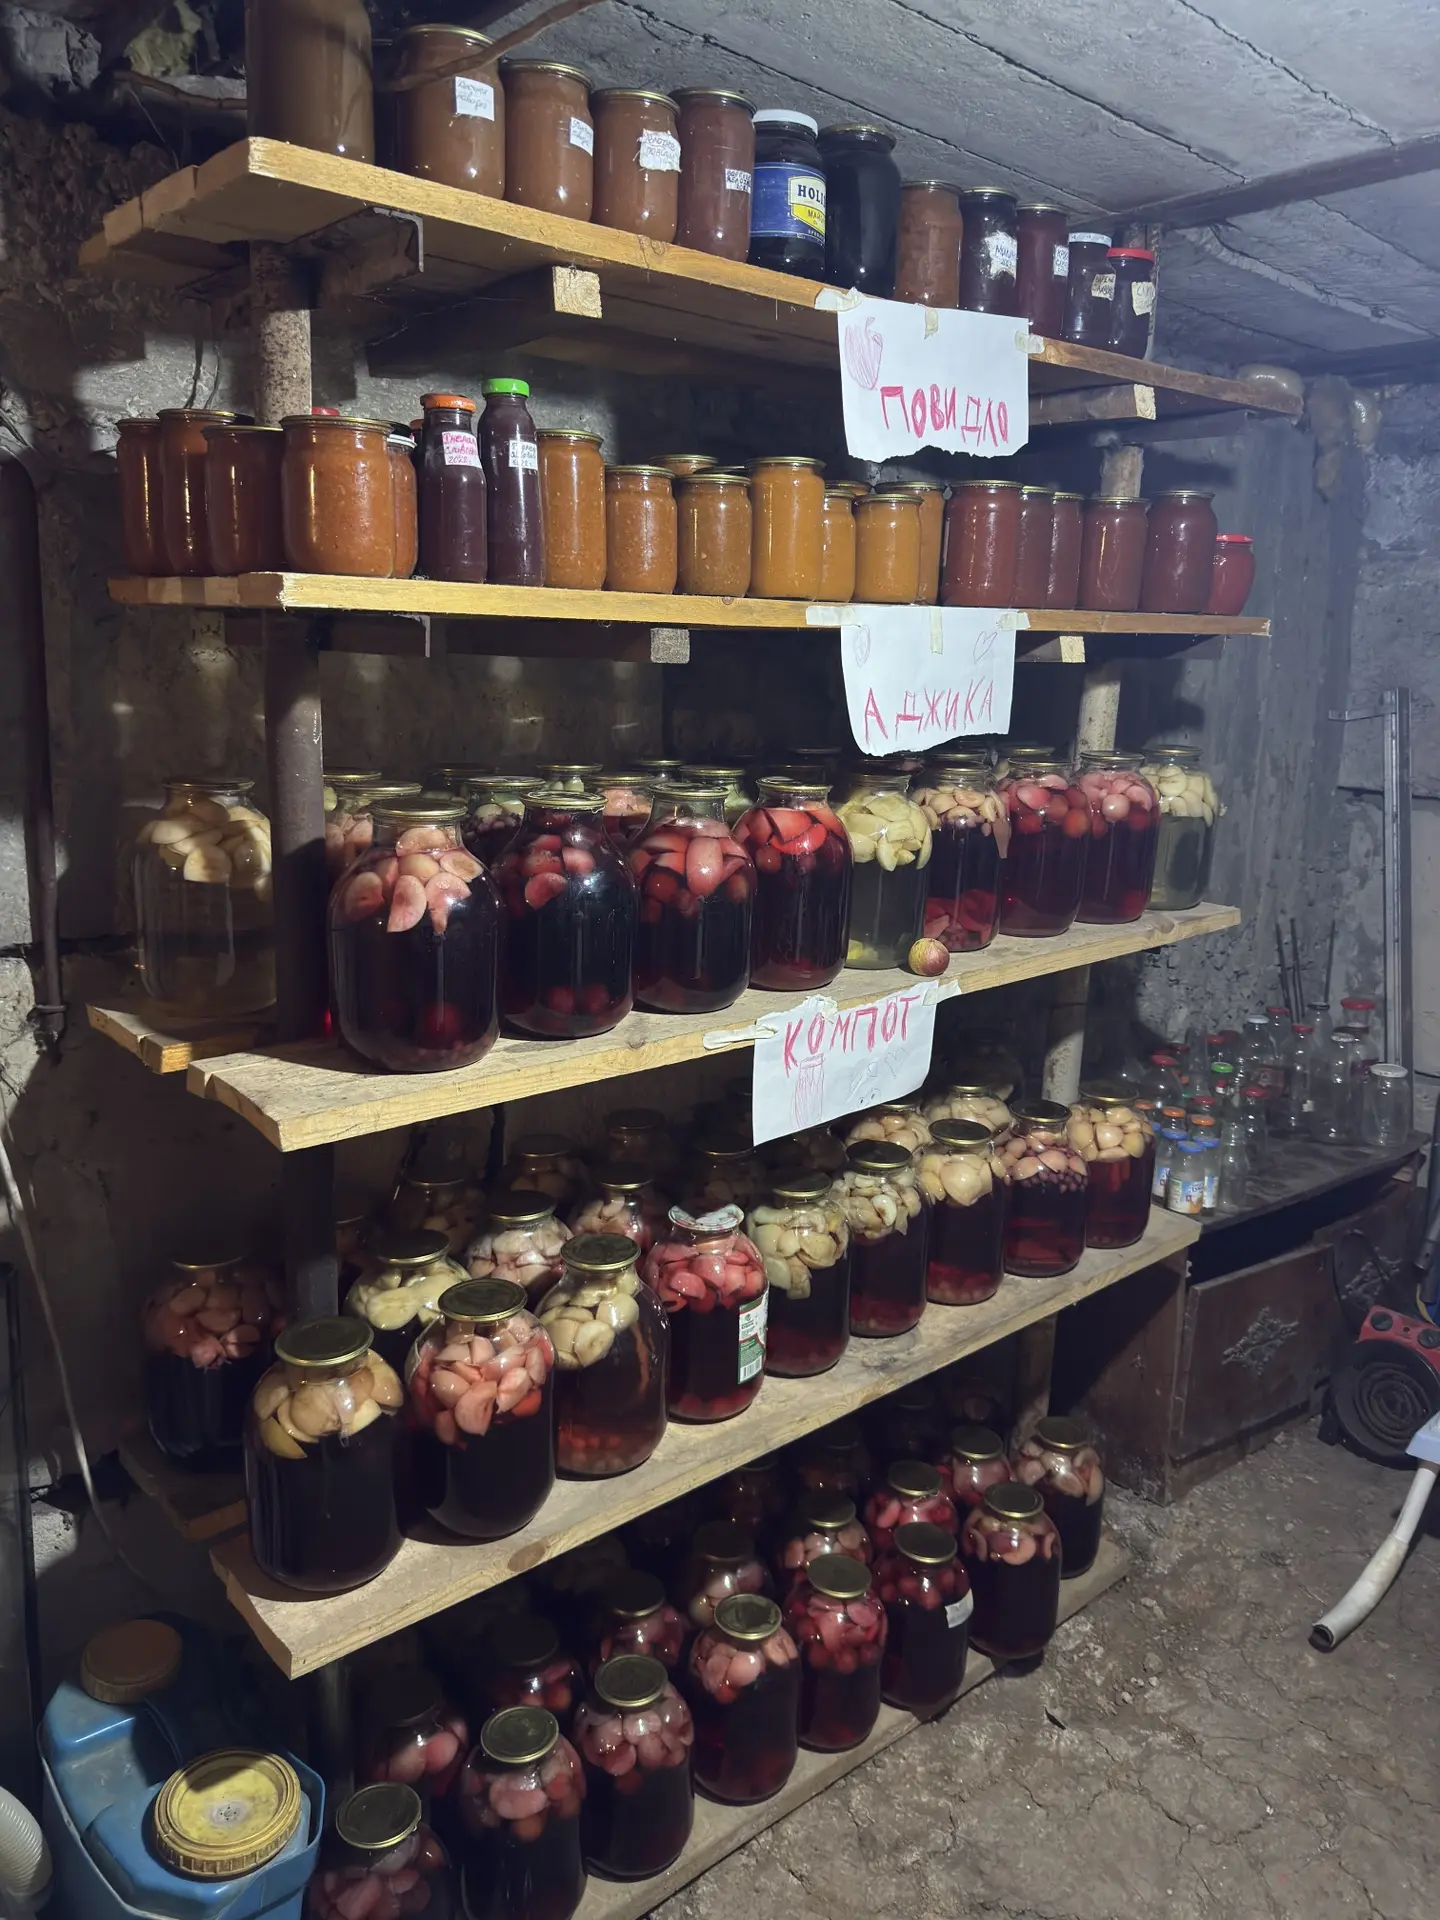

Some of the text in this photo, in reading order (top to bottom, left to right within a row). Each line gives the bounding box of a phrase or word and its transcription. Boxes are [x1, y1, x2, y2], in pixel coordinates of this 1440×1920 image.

[880, 383, 1009, 447] ПОВИДЛО
[865, 676, 993, 745] АДЖИКА
[784, 994, 921, 1078] КОМПОТ
